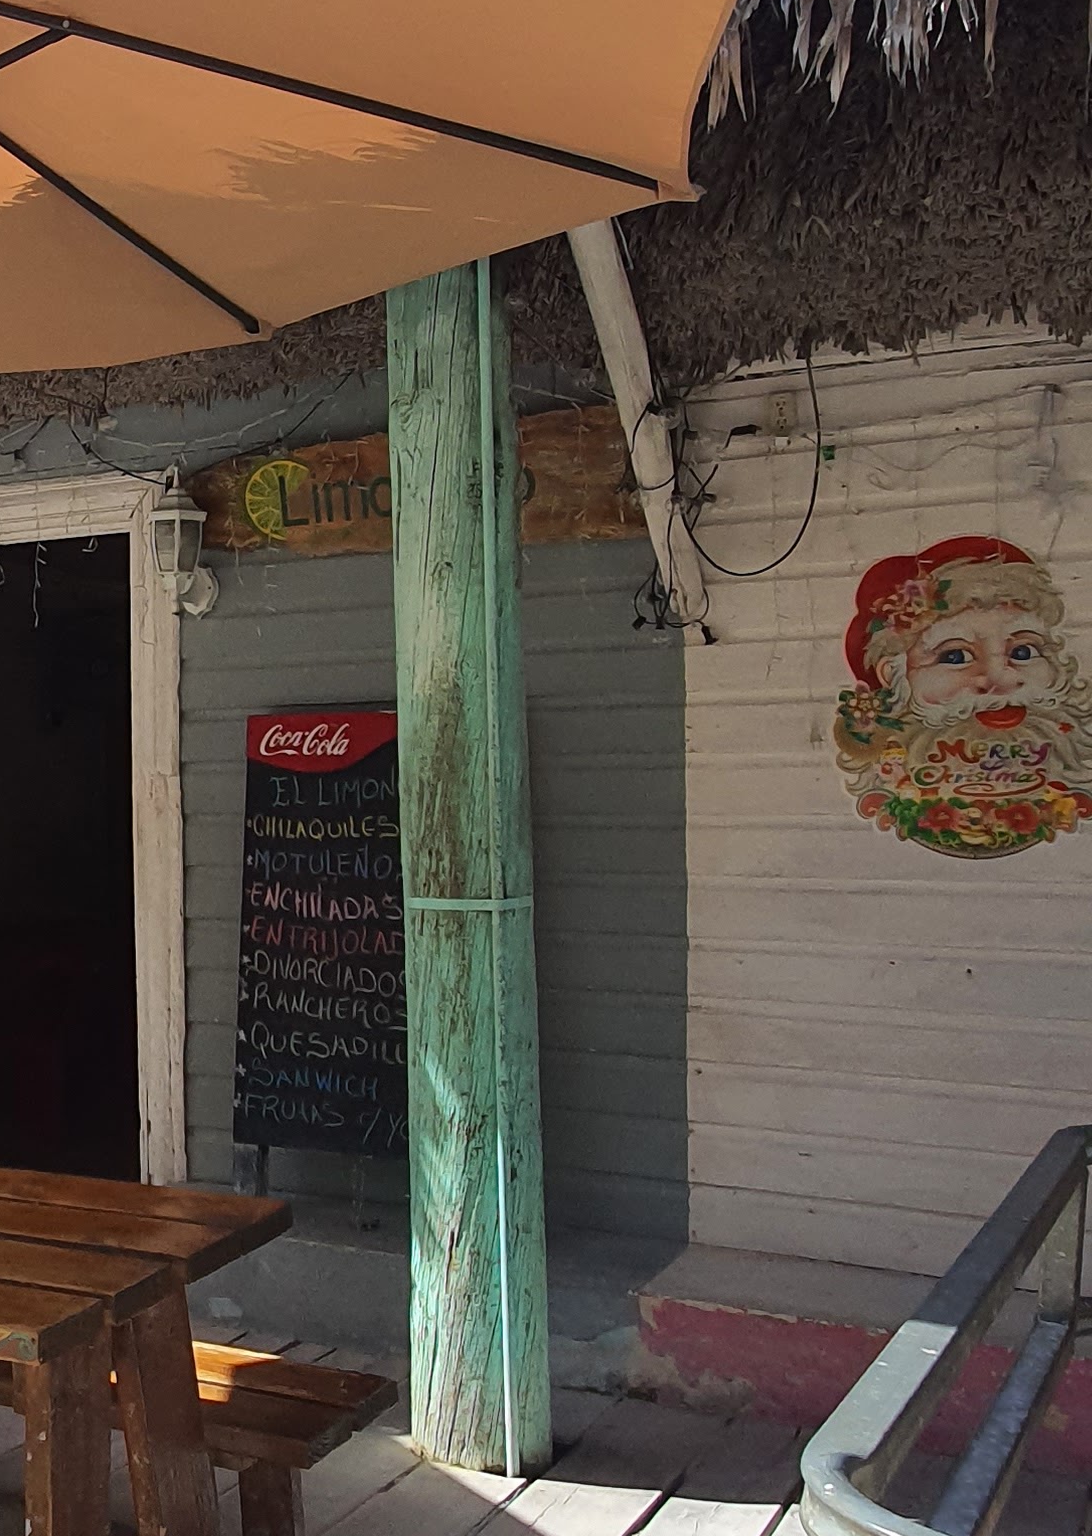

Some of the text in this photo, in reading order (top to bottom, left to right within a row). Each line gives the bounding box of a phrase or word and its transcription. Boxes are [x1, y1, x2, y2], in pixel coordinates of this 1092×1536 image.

[260, 723, 350, 756] Coca-Cola
[270, 765, 395, 808] EL LIMON
[254, 815, 399, 841] CHILAQUILES
[254, 843, 402, 880] MOTULEÑO
[251, 881, 403, 921] ENCHILADAS
[249, 1058, 378, 1101] SANWICH
